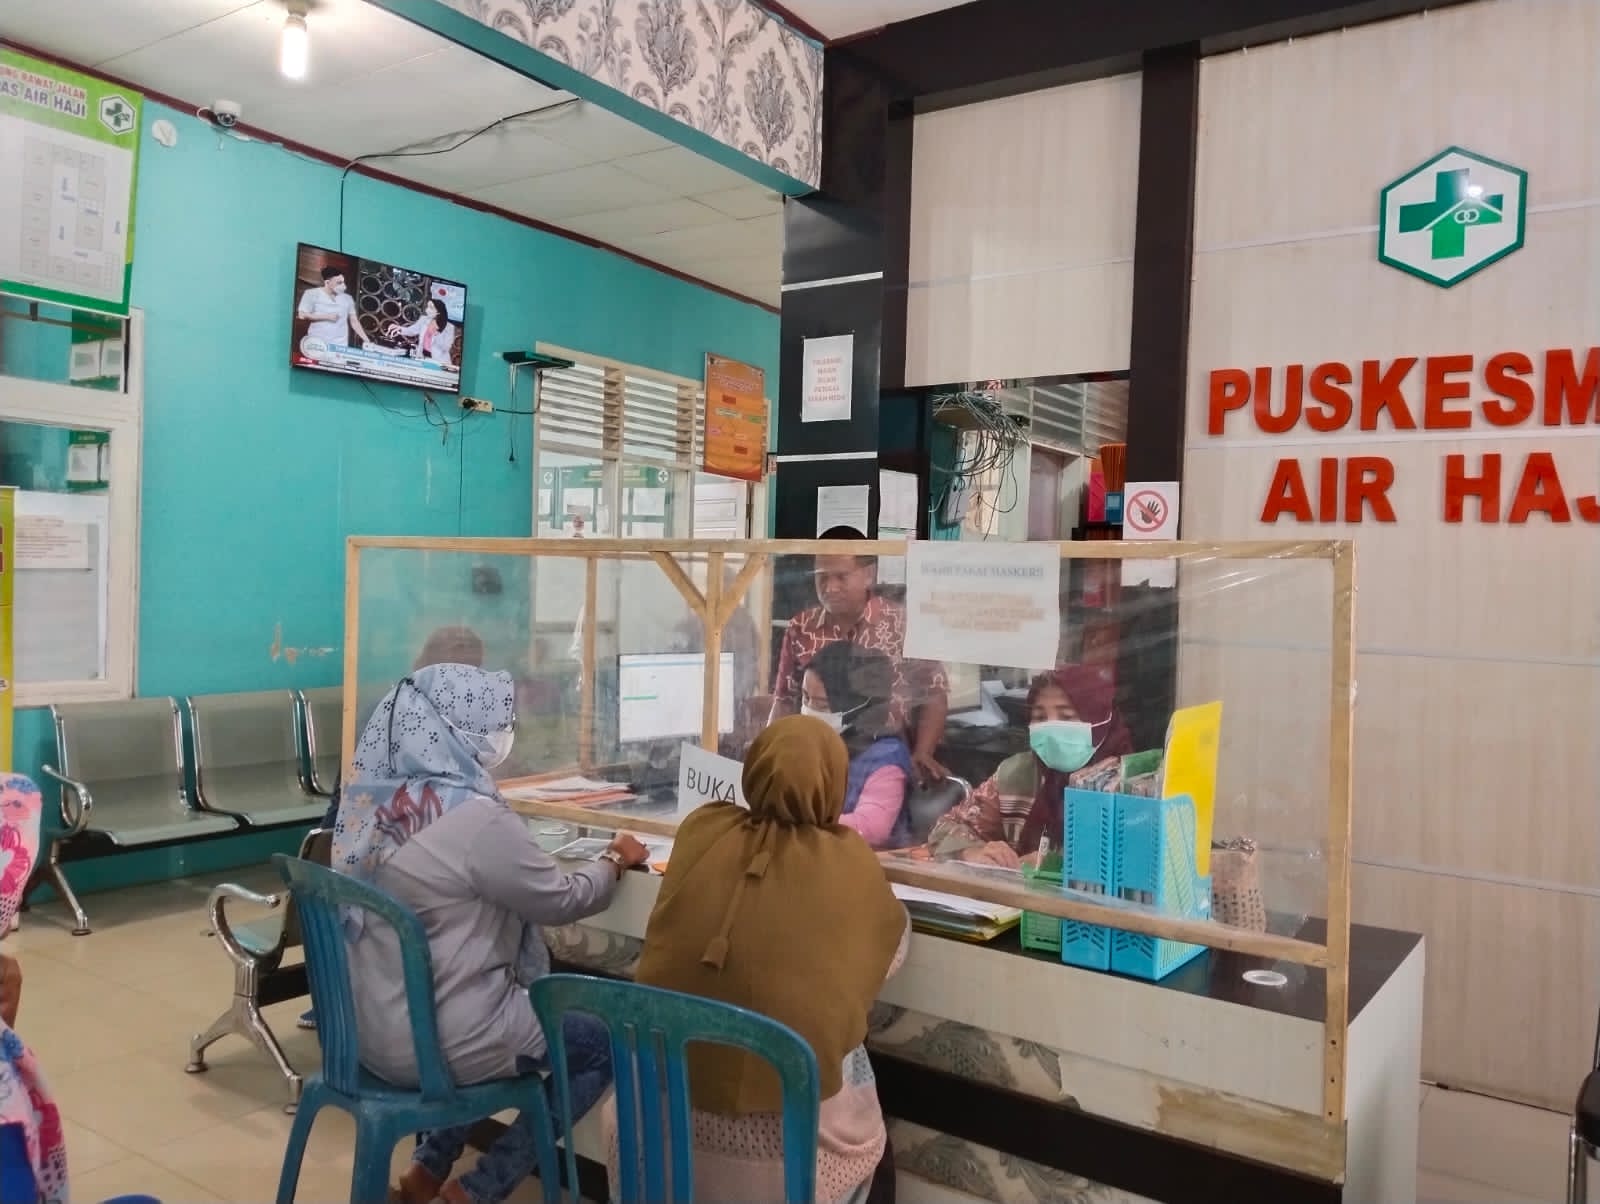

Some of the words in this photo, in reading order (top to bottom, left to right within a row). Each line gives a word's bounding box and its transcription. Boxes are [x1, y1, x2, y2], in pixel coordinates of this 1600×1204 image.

[24, 87, 48, 105] AIR
[54, 95, 86, 117] HAJI
[1207, 346, 1600, 436] PUSKESM
[1260, 456, 1398, 523] AIR
[1444, 451, 1600, 523] HAJ
[686, 767, 736, 805] BUKA
